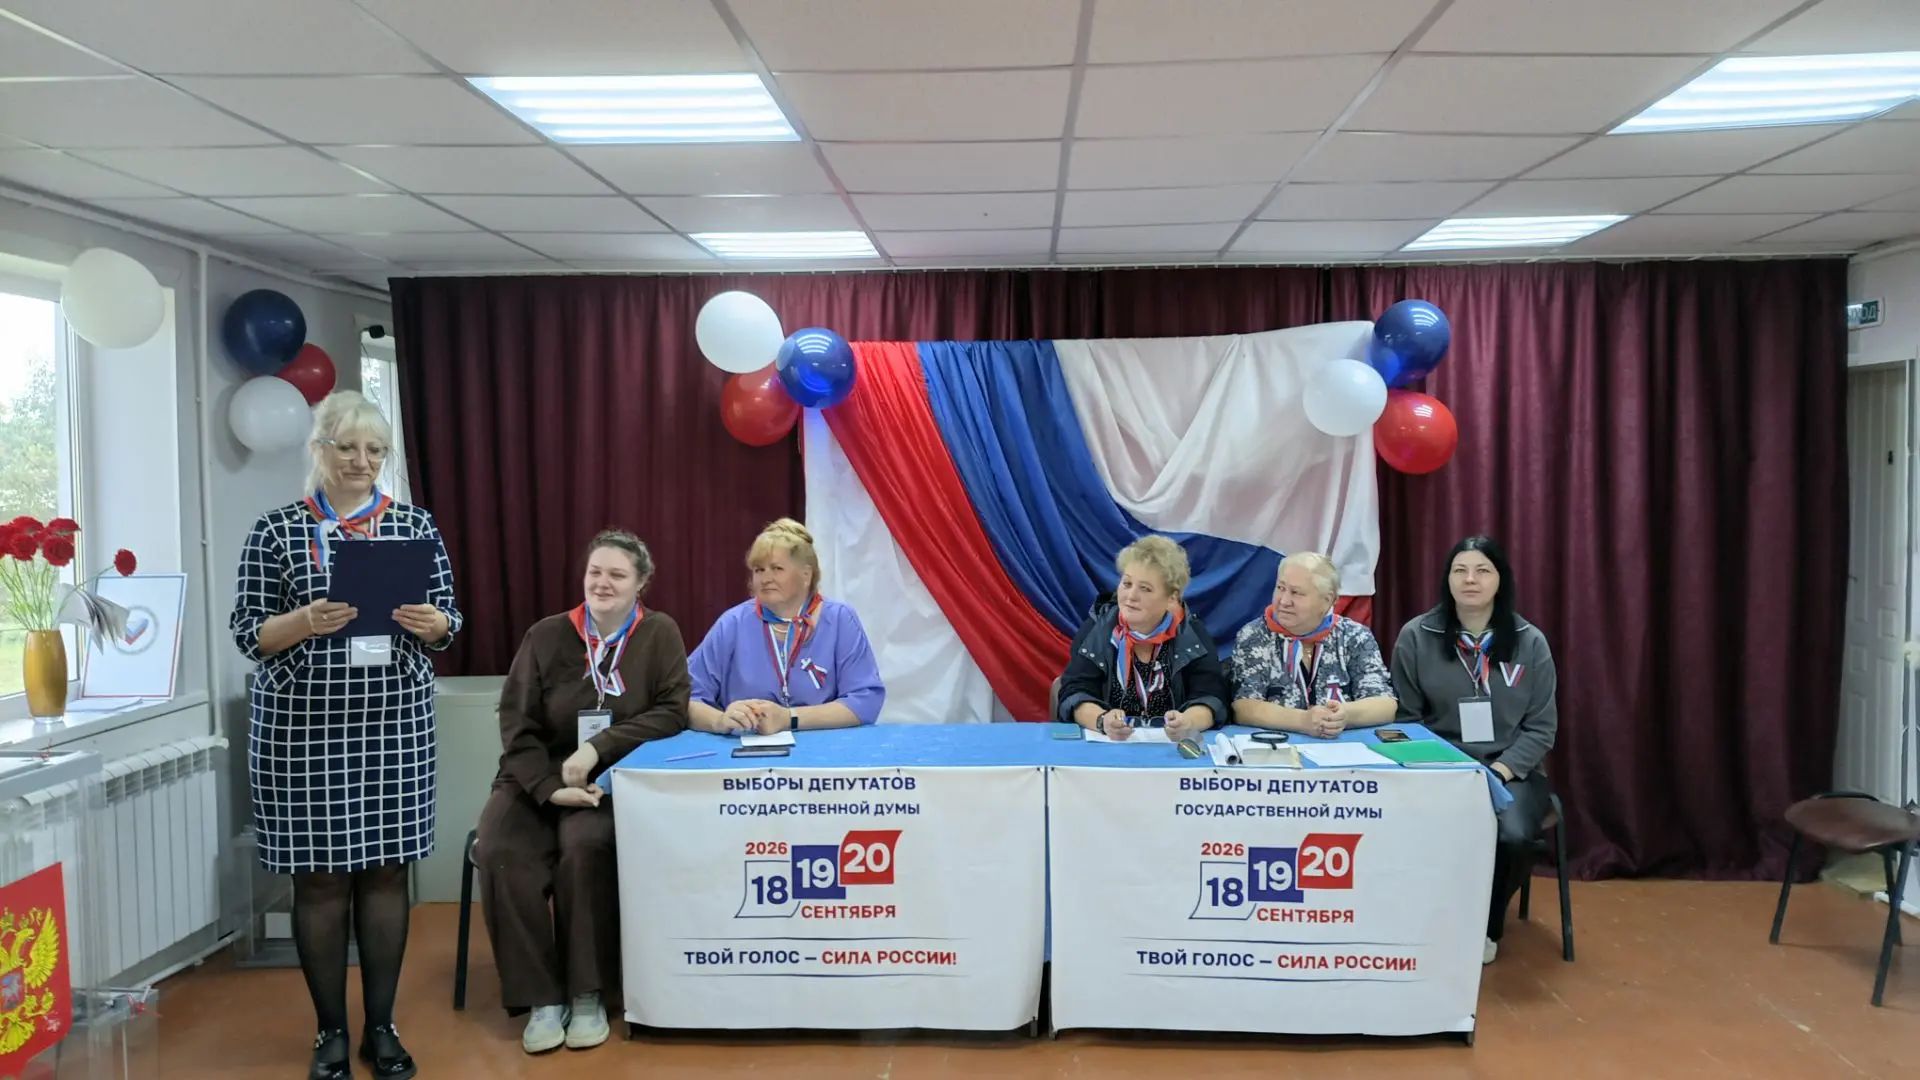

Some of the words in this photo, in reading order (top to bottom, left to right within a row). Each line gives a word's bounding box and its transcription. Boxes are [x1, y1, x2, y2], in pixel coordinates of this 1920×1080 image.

[723, 777, 804, 791] ВЫБОРЫ
[808, 777, 916, 792] ДЕПУТАТОВ
[1179, 777, 1262, 792] ВЫБОРЫ
[1267, 779, 1379, 795] ДЕПУТАТОВ
[719, 801, 870, 816] ГОСУДАРСТВЕННОЙ
[874, 803, 920, 817] ДУМЫ
[1175, 803, 1330, 819] ГОСУДАРСТВЕННОЙ
[1334, 806, 1383, 820] ДУМЫ
[745, 842, 788, 855] 2026
[1201, 842, 1245, 856] 2026
[751, 875, 789, 905] 18
[796, 858, 836, 889] 19
[843, 842, 891, 873] 20
[1206, 877, 1245, 907] 18
[1253, 860, 1293, 891] 19
[1302, 846, 1350, 877] 20
[801, 905, 896, 919] СЕНТЯБРЯ
[1256, 908, 1354, 923] СЕНТЯБРЯ
[684, 948, 734, 965] ТВОЙ
[739, 950, 799, 965] ГОЛОС
[822, 950, 872, 965] СИЛА
[877, 951, 957, 966] РОССИИ!
[1137, 949, 1187, 966] ТВОЙ
[1193, 952, 1254, 967] ГОЛОС
[1277, 955, 1329, 970] СИЛА
[1335, 956, 1417, 971] РОССИИ!
